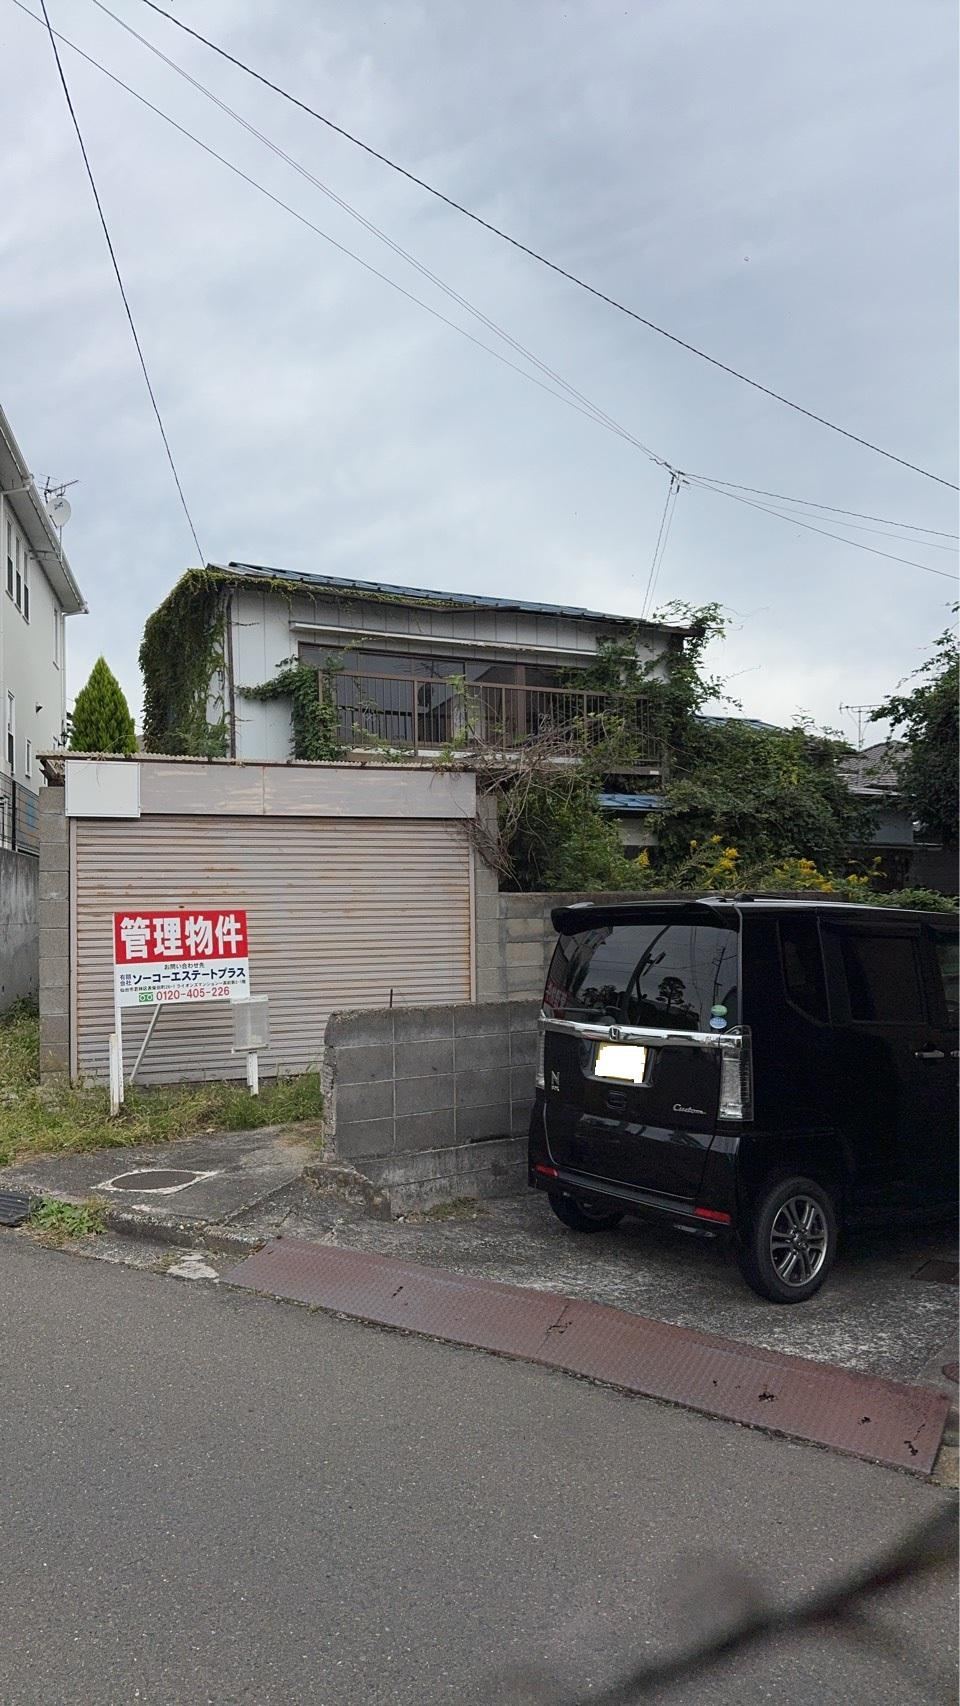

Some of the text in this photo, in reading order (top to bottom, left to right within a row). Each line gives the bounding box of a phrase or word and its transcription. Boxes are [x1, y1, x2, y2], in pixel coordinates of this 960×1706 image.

[120, 914, 243, 960] 管理物件
[164, 962, 205, 970] お問い合わせ先
[132, 967, 246, 985] ソーコーエステートプラス
[156, 986, 230, 1001] 0120-405-226
[672, 1103, 706, 1115] Custom
